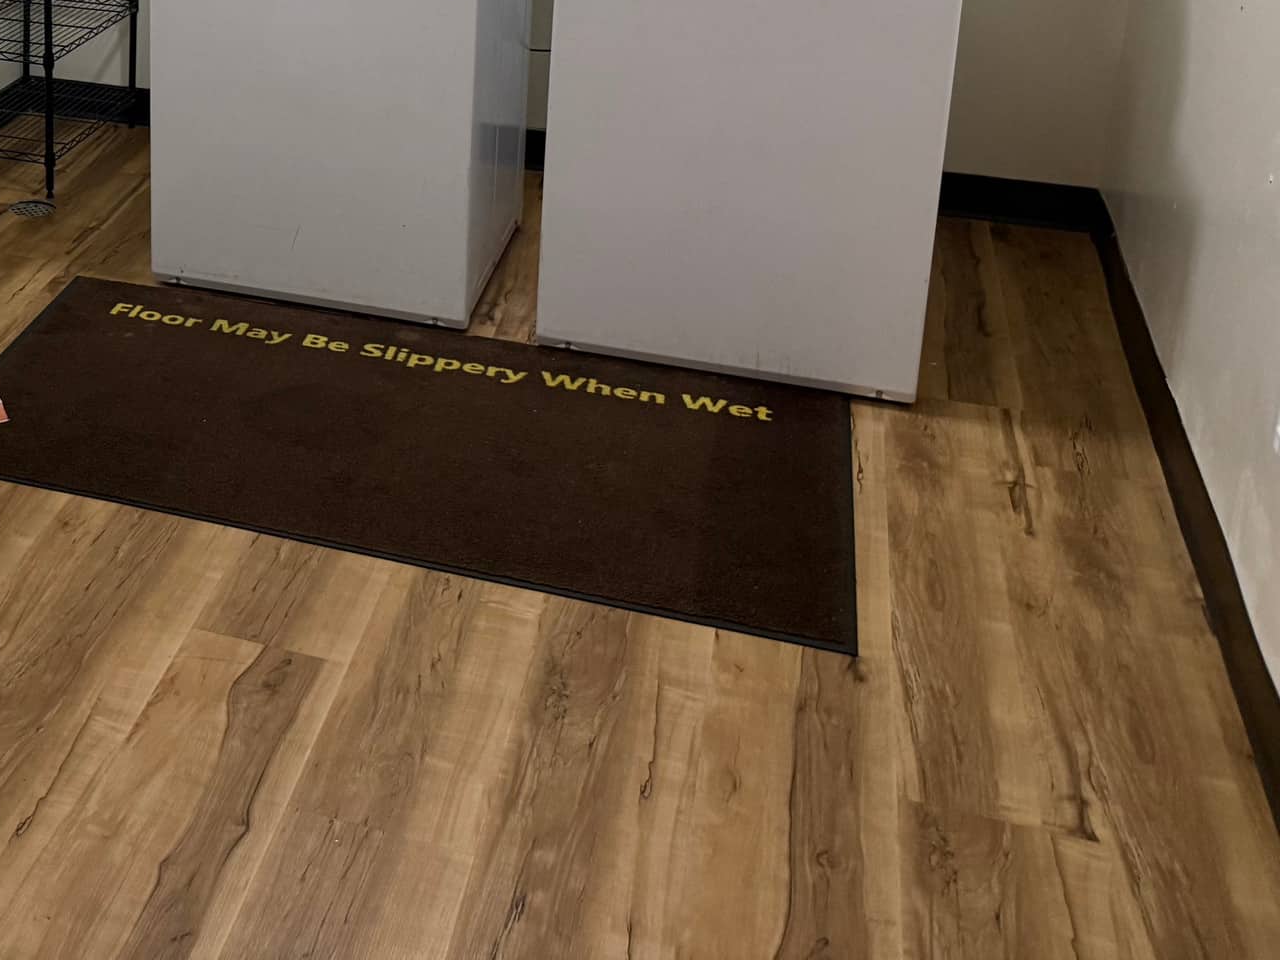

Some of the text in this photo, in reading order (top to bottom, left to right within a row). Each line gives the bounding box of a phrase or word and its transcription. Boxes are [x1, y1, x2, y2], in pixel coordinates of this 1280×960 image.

[109, 302, 774, 422] Floor May Be Slippery When Wet
